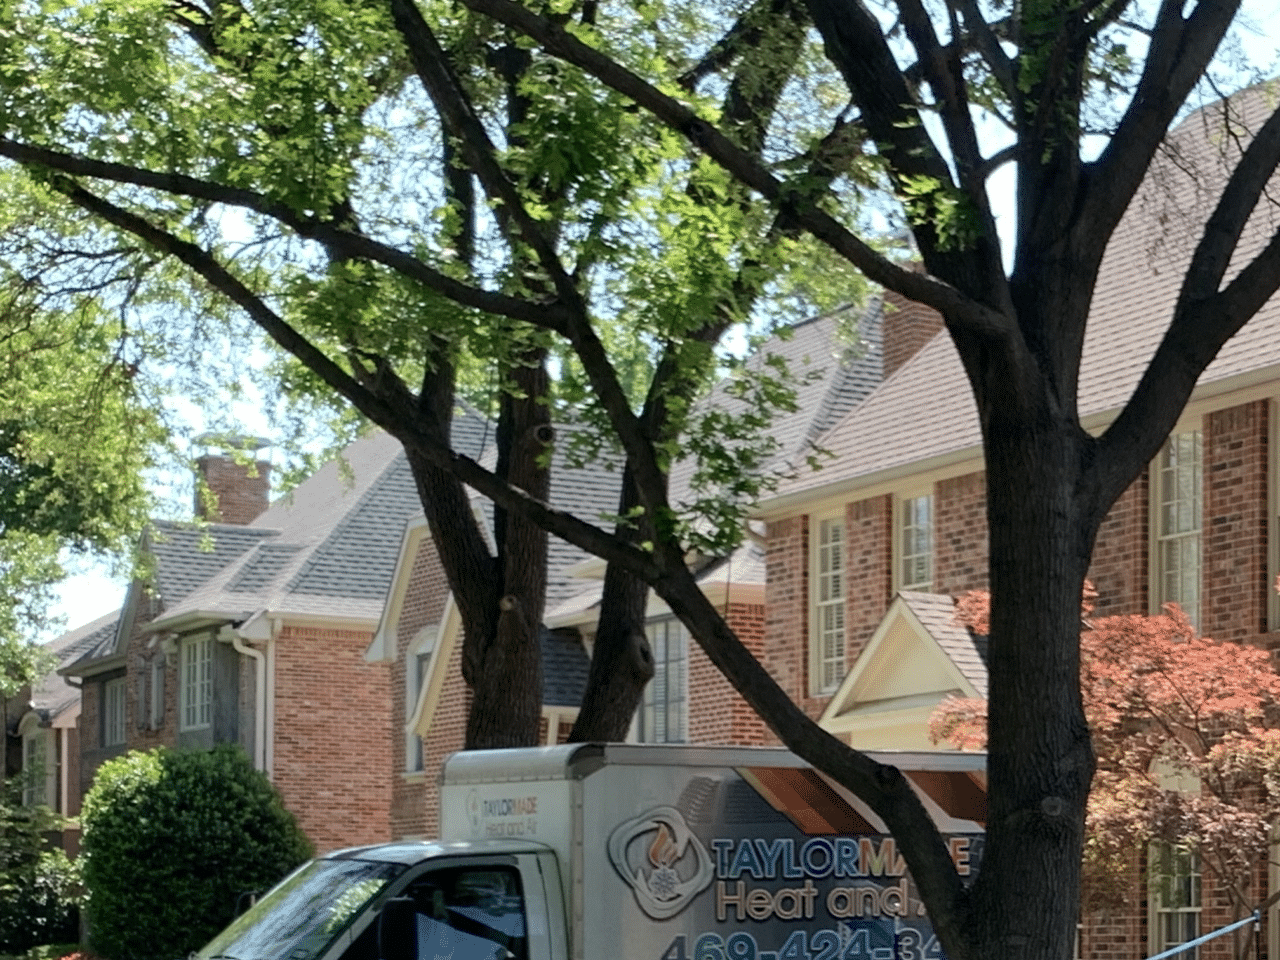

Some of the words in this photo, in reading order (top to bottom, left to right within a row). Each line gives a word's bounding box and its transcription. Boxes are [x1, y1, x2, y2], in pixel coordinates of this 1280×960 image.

[711, 836, 971, 880] TAYLORME
[715, 878, 819, 921] Heat
[826, 876, 909, 918] and
